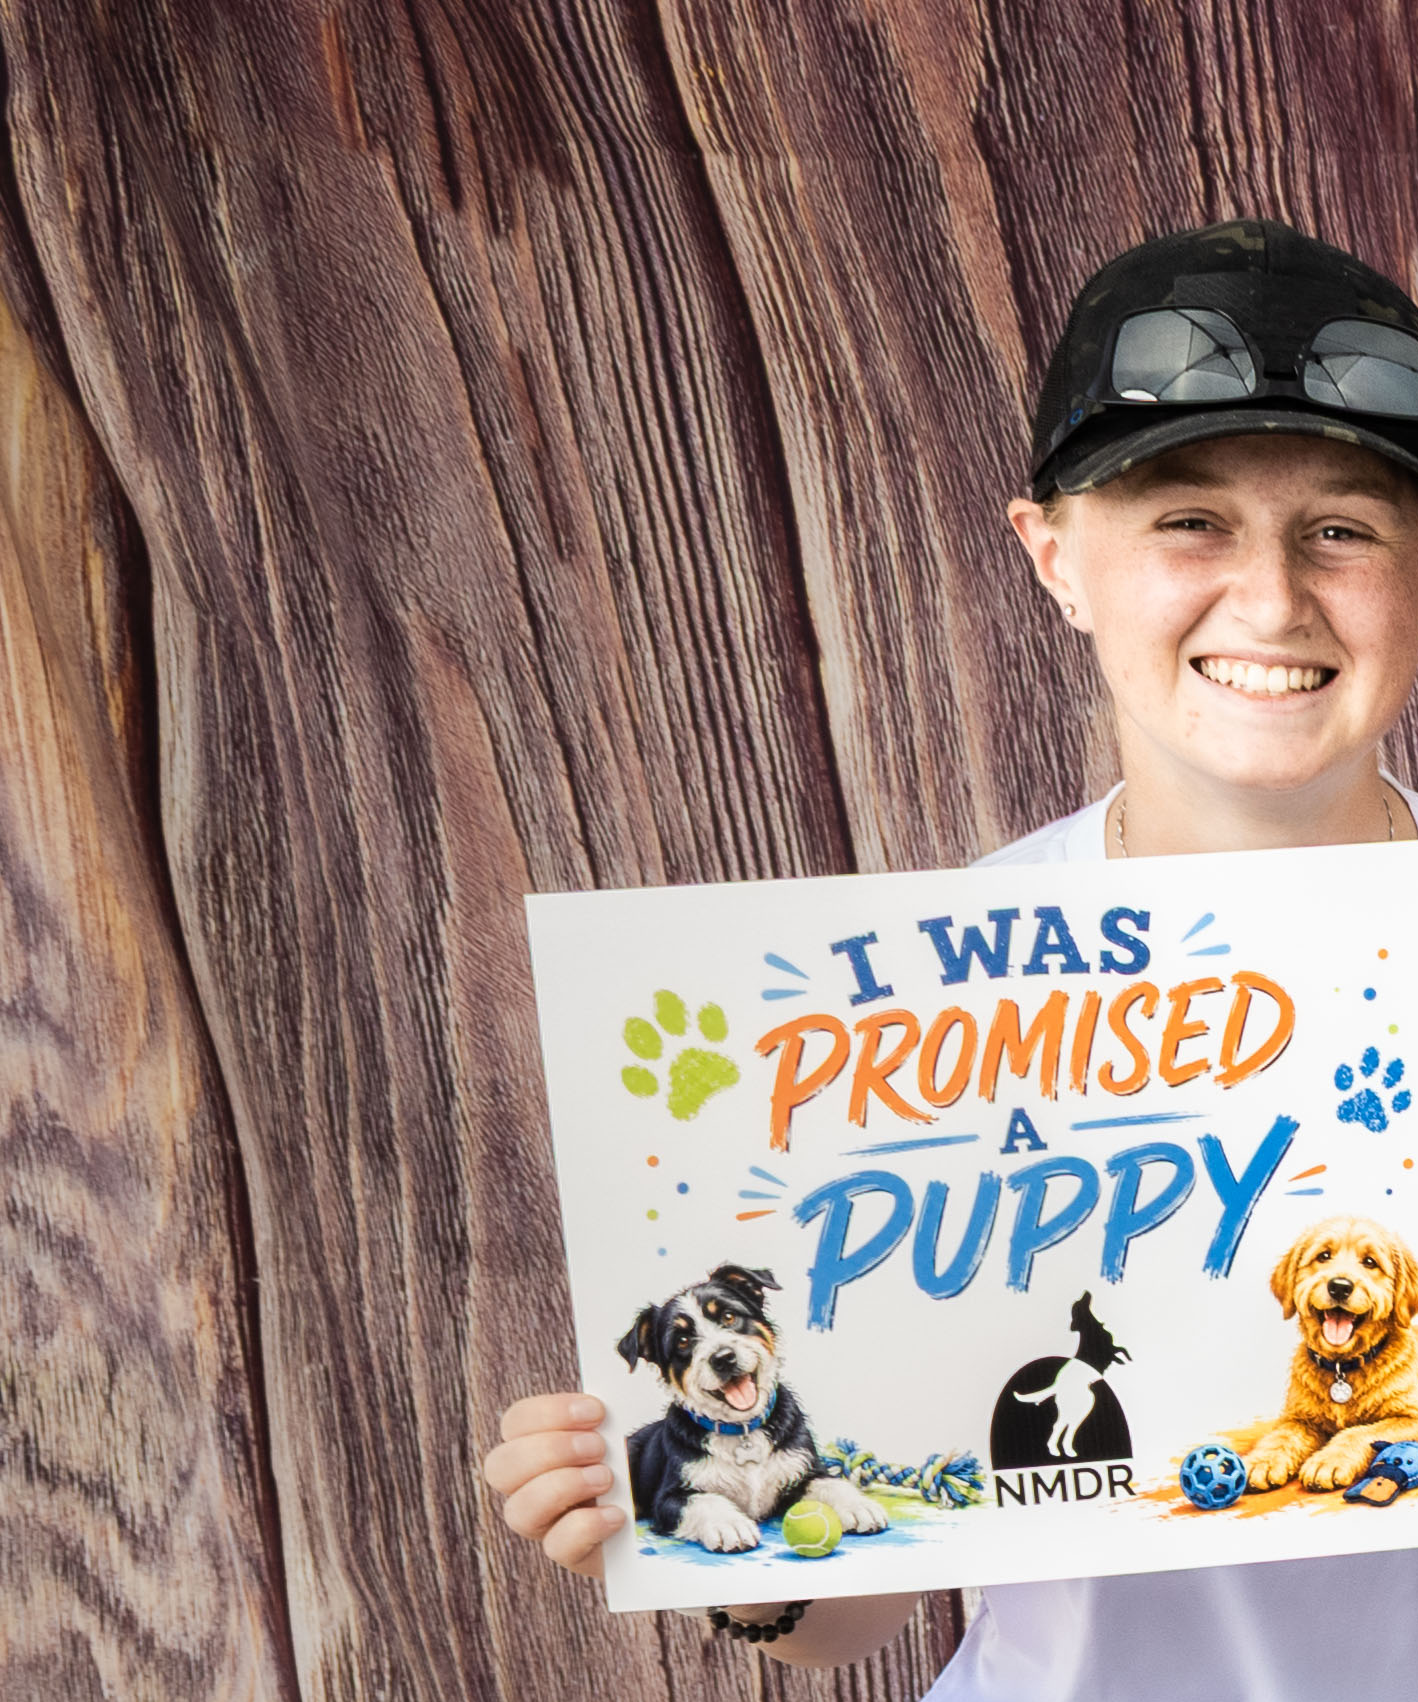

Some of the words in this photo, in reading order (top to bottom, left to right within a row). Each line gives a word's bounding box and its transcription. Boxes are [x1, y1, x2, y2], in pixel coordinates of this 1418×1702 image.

[831, 931, 894, 1006] I
[919, 907, 1151, 985] WAS
[756, 972, 1295, 1152] PROMISED
[1000, 1110, 1048, 1154] A
[794, 1116, 1300, 1332] PUPPY
[994, 1464, 1137, 1508] NMDR
